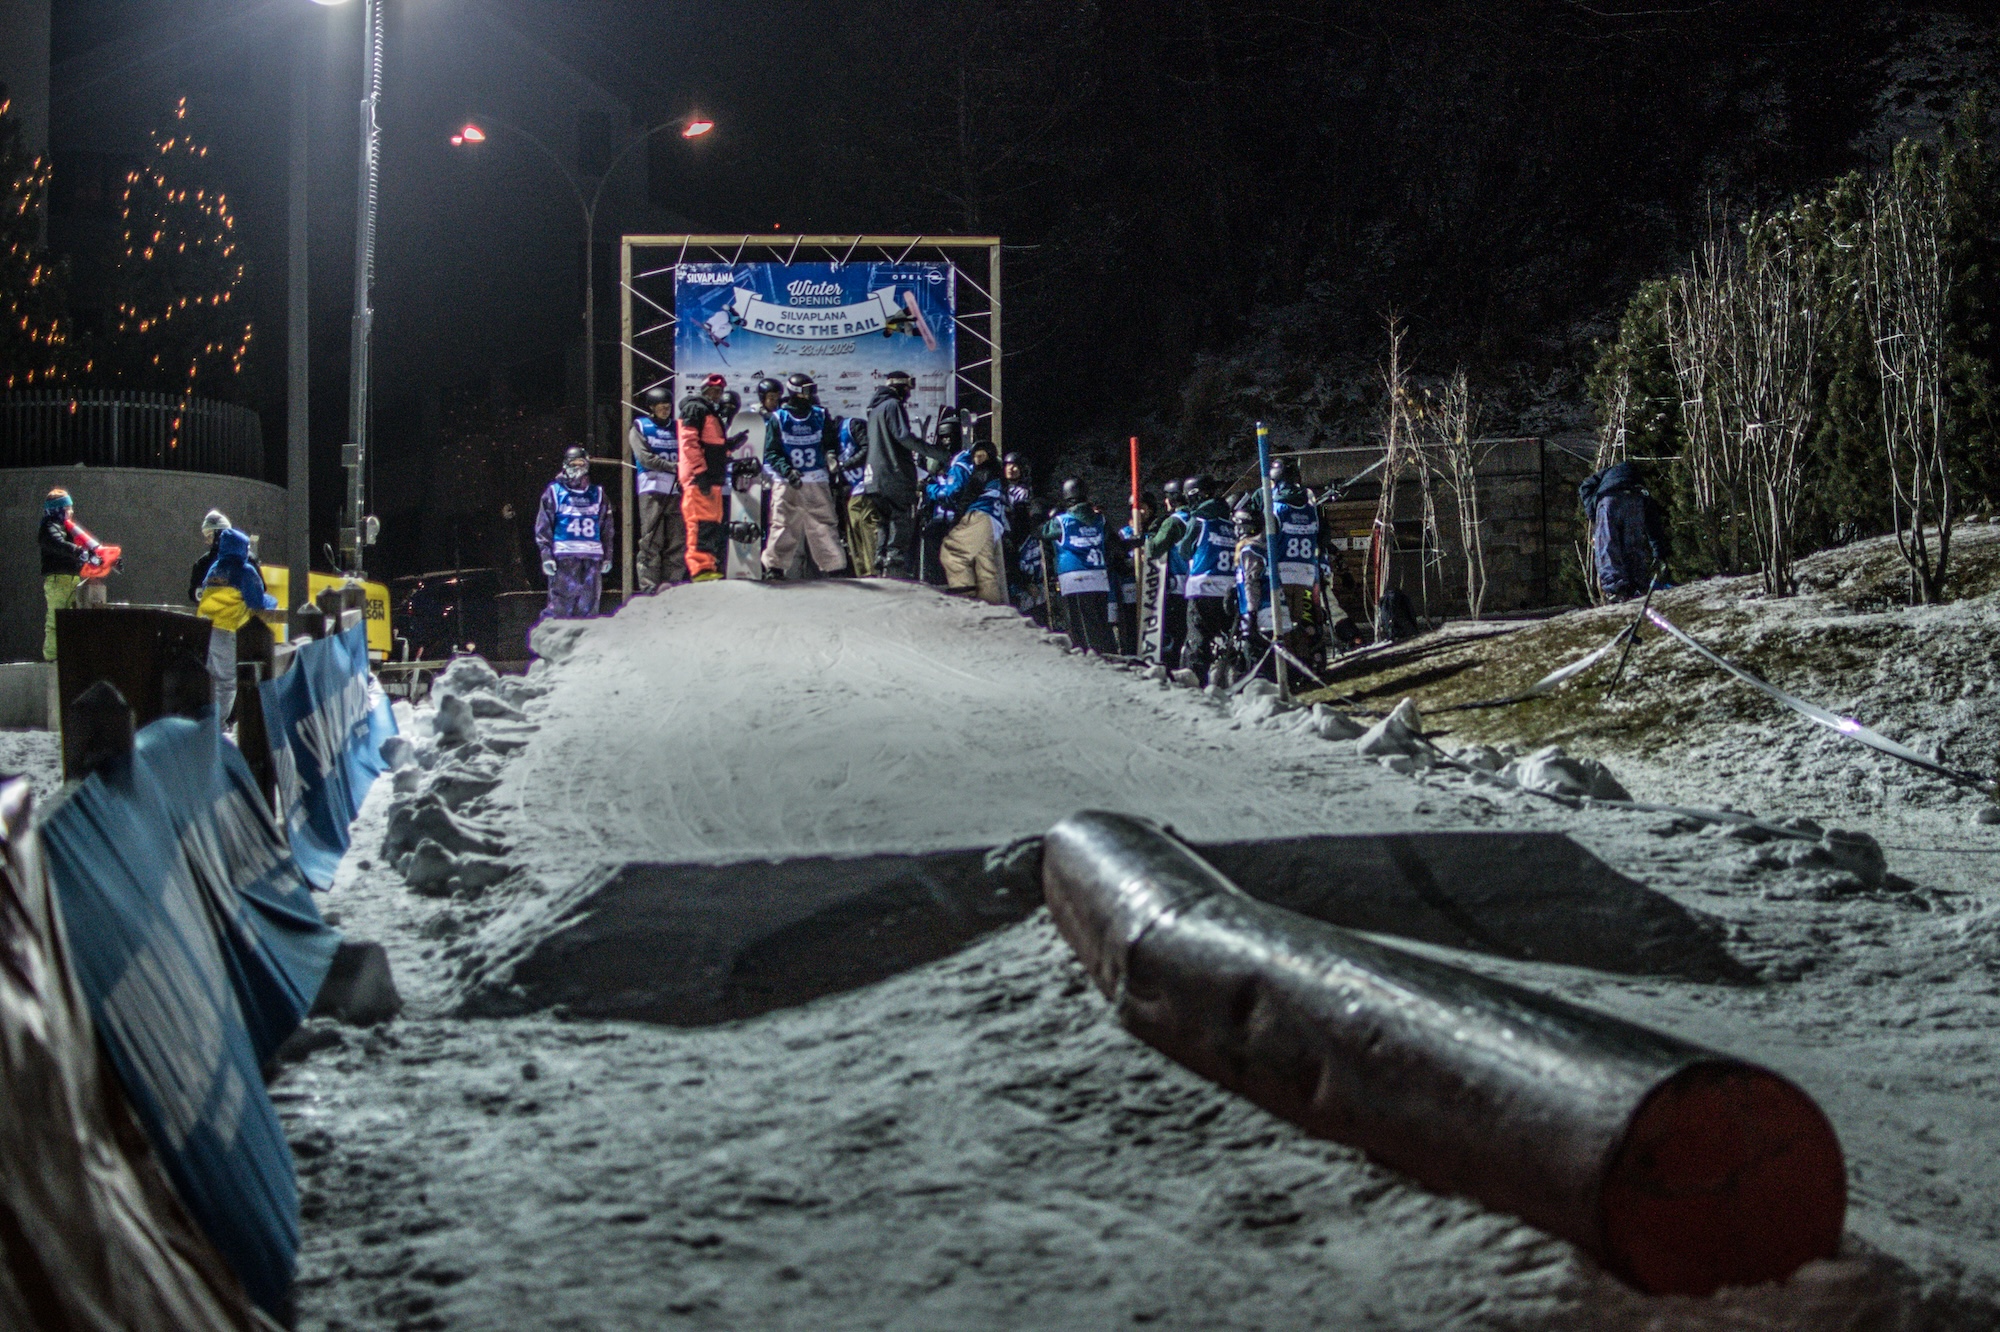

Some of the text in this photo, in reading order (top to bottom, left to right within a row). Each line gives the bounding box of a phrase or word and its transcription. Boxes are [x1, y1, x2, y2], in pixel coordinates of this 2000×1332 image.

[686, 272, 735, 283] SILVAPLANA
[787, 279, 843, 297] Winter
[789, 296, 841, 306] OPENING
[780, 310, 847, 321] SILVAPLANA
[754, 317, 880, 336] ROCKS THE RAIL
[790, 448, 816, 468] 83
[566, 518, 596, 537] 48
[1286, 538, 1312, 559] 88
[365, 599, 384, 610] KER
[1142, 557, 1161, 665] APPY PLAC
[365, 609, 385, 621] SON
